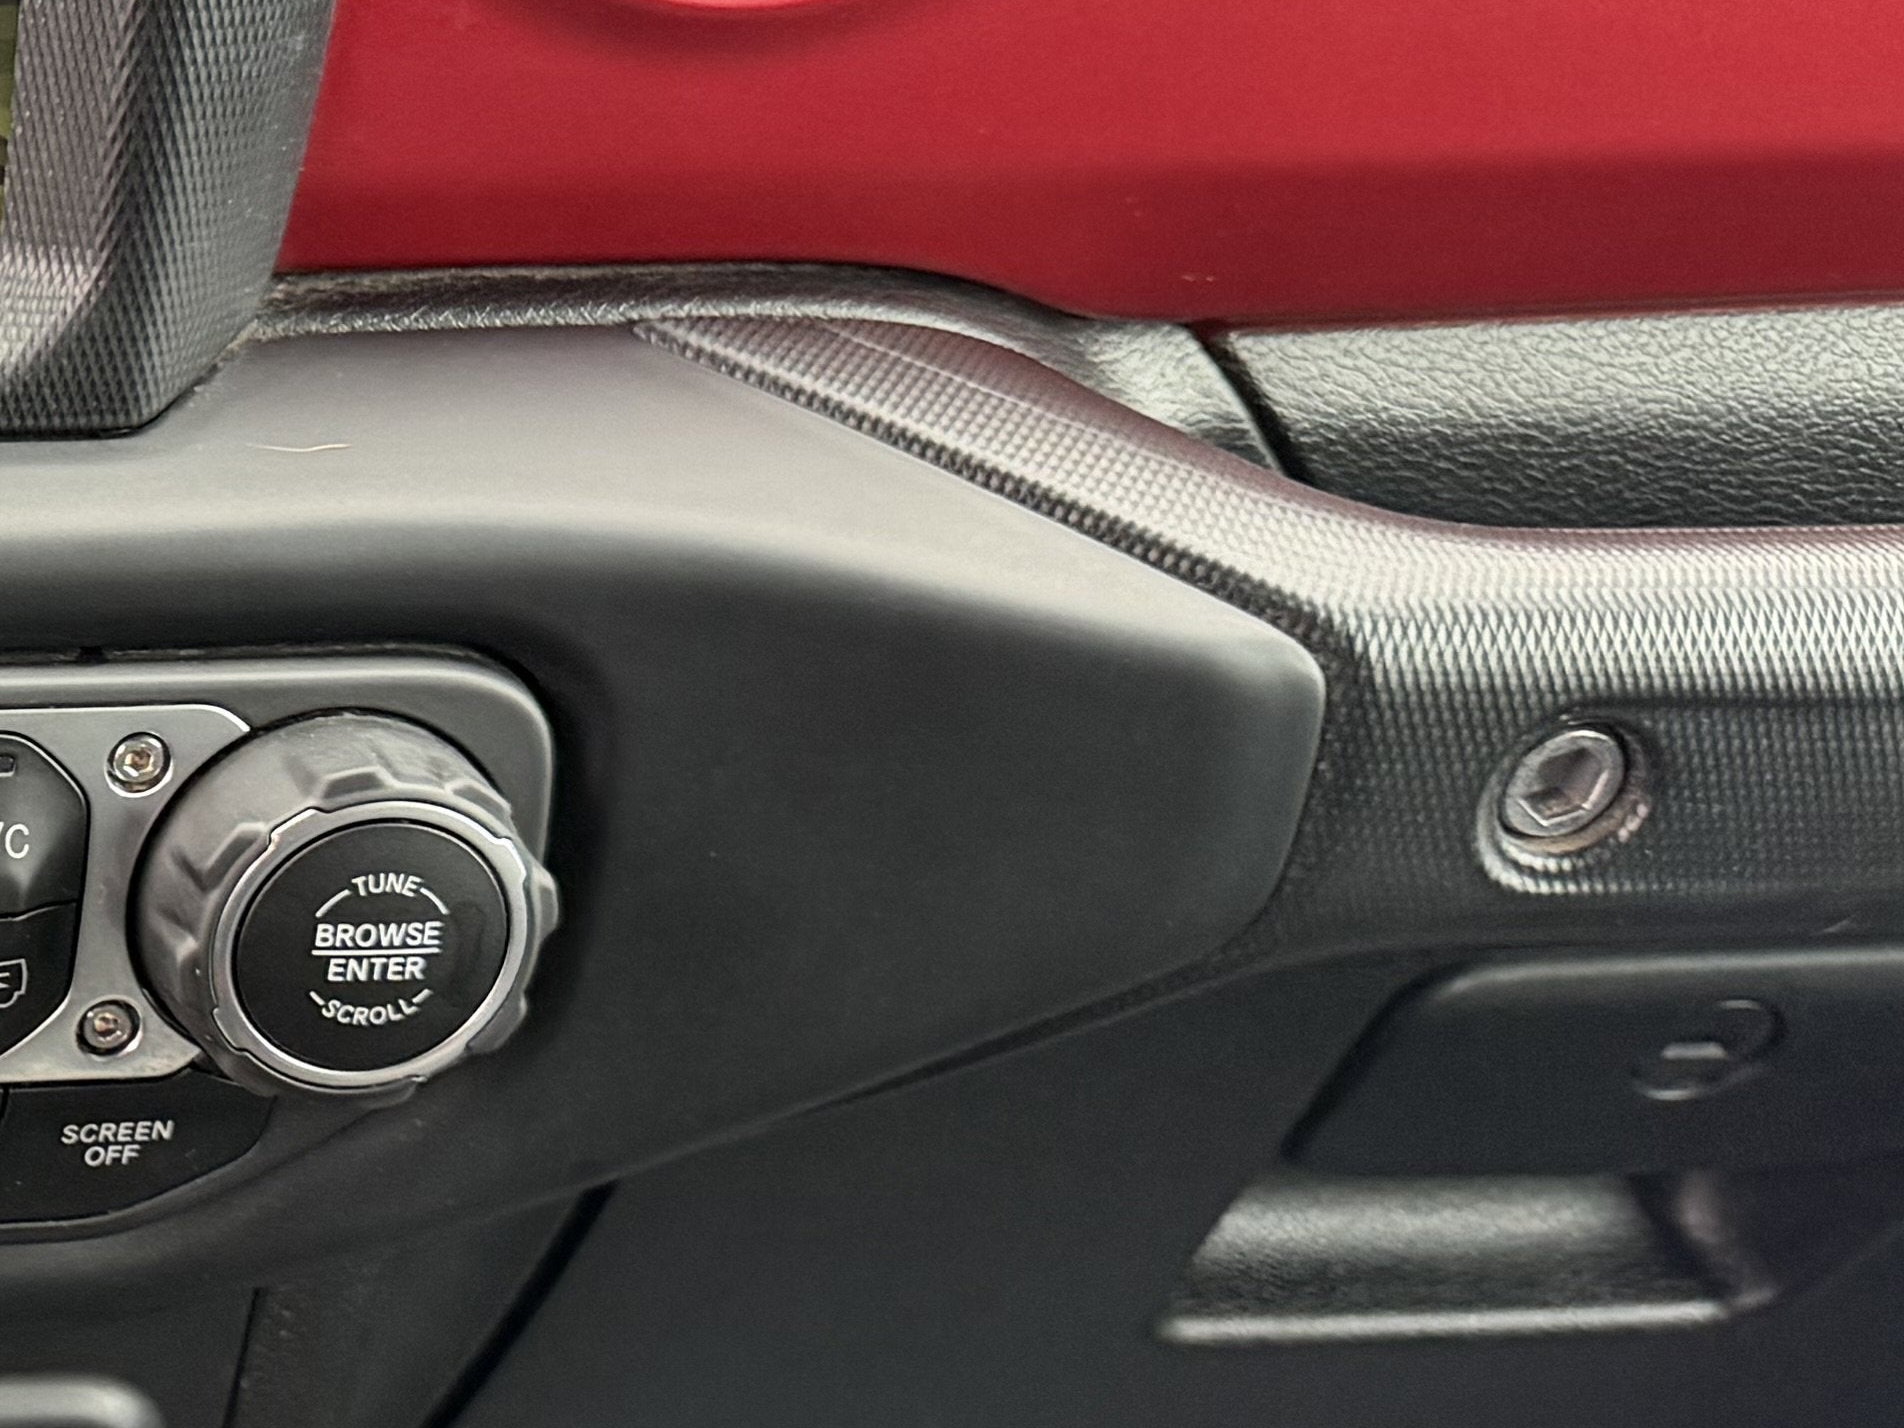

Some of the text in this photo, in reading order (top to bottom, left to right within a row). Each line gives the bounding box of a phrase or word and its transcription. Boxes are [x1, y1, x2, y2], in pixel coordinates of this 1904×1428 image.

[352, 873, 422, 897] TUNE
[314, 922, 444, 948] BROWSE
[327, 957, 426, 981] ENTER
[321, 999, 421, 1026] SCROLL
[61, 1120, 175, 1144] SCREEN
[84, 1145, 141, 1167] OFF
